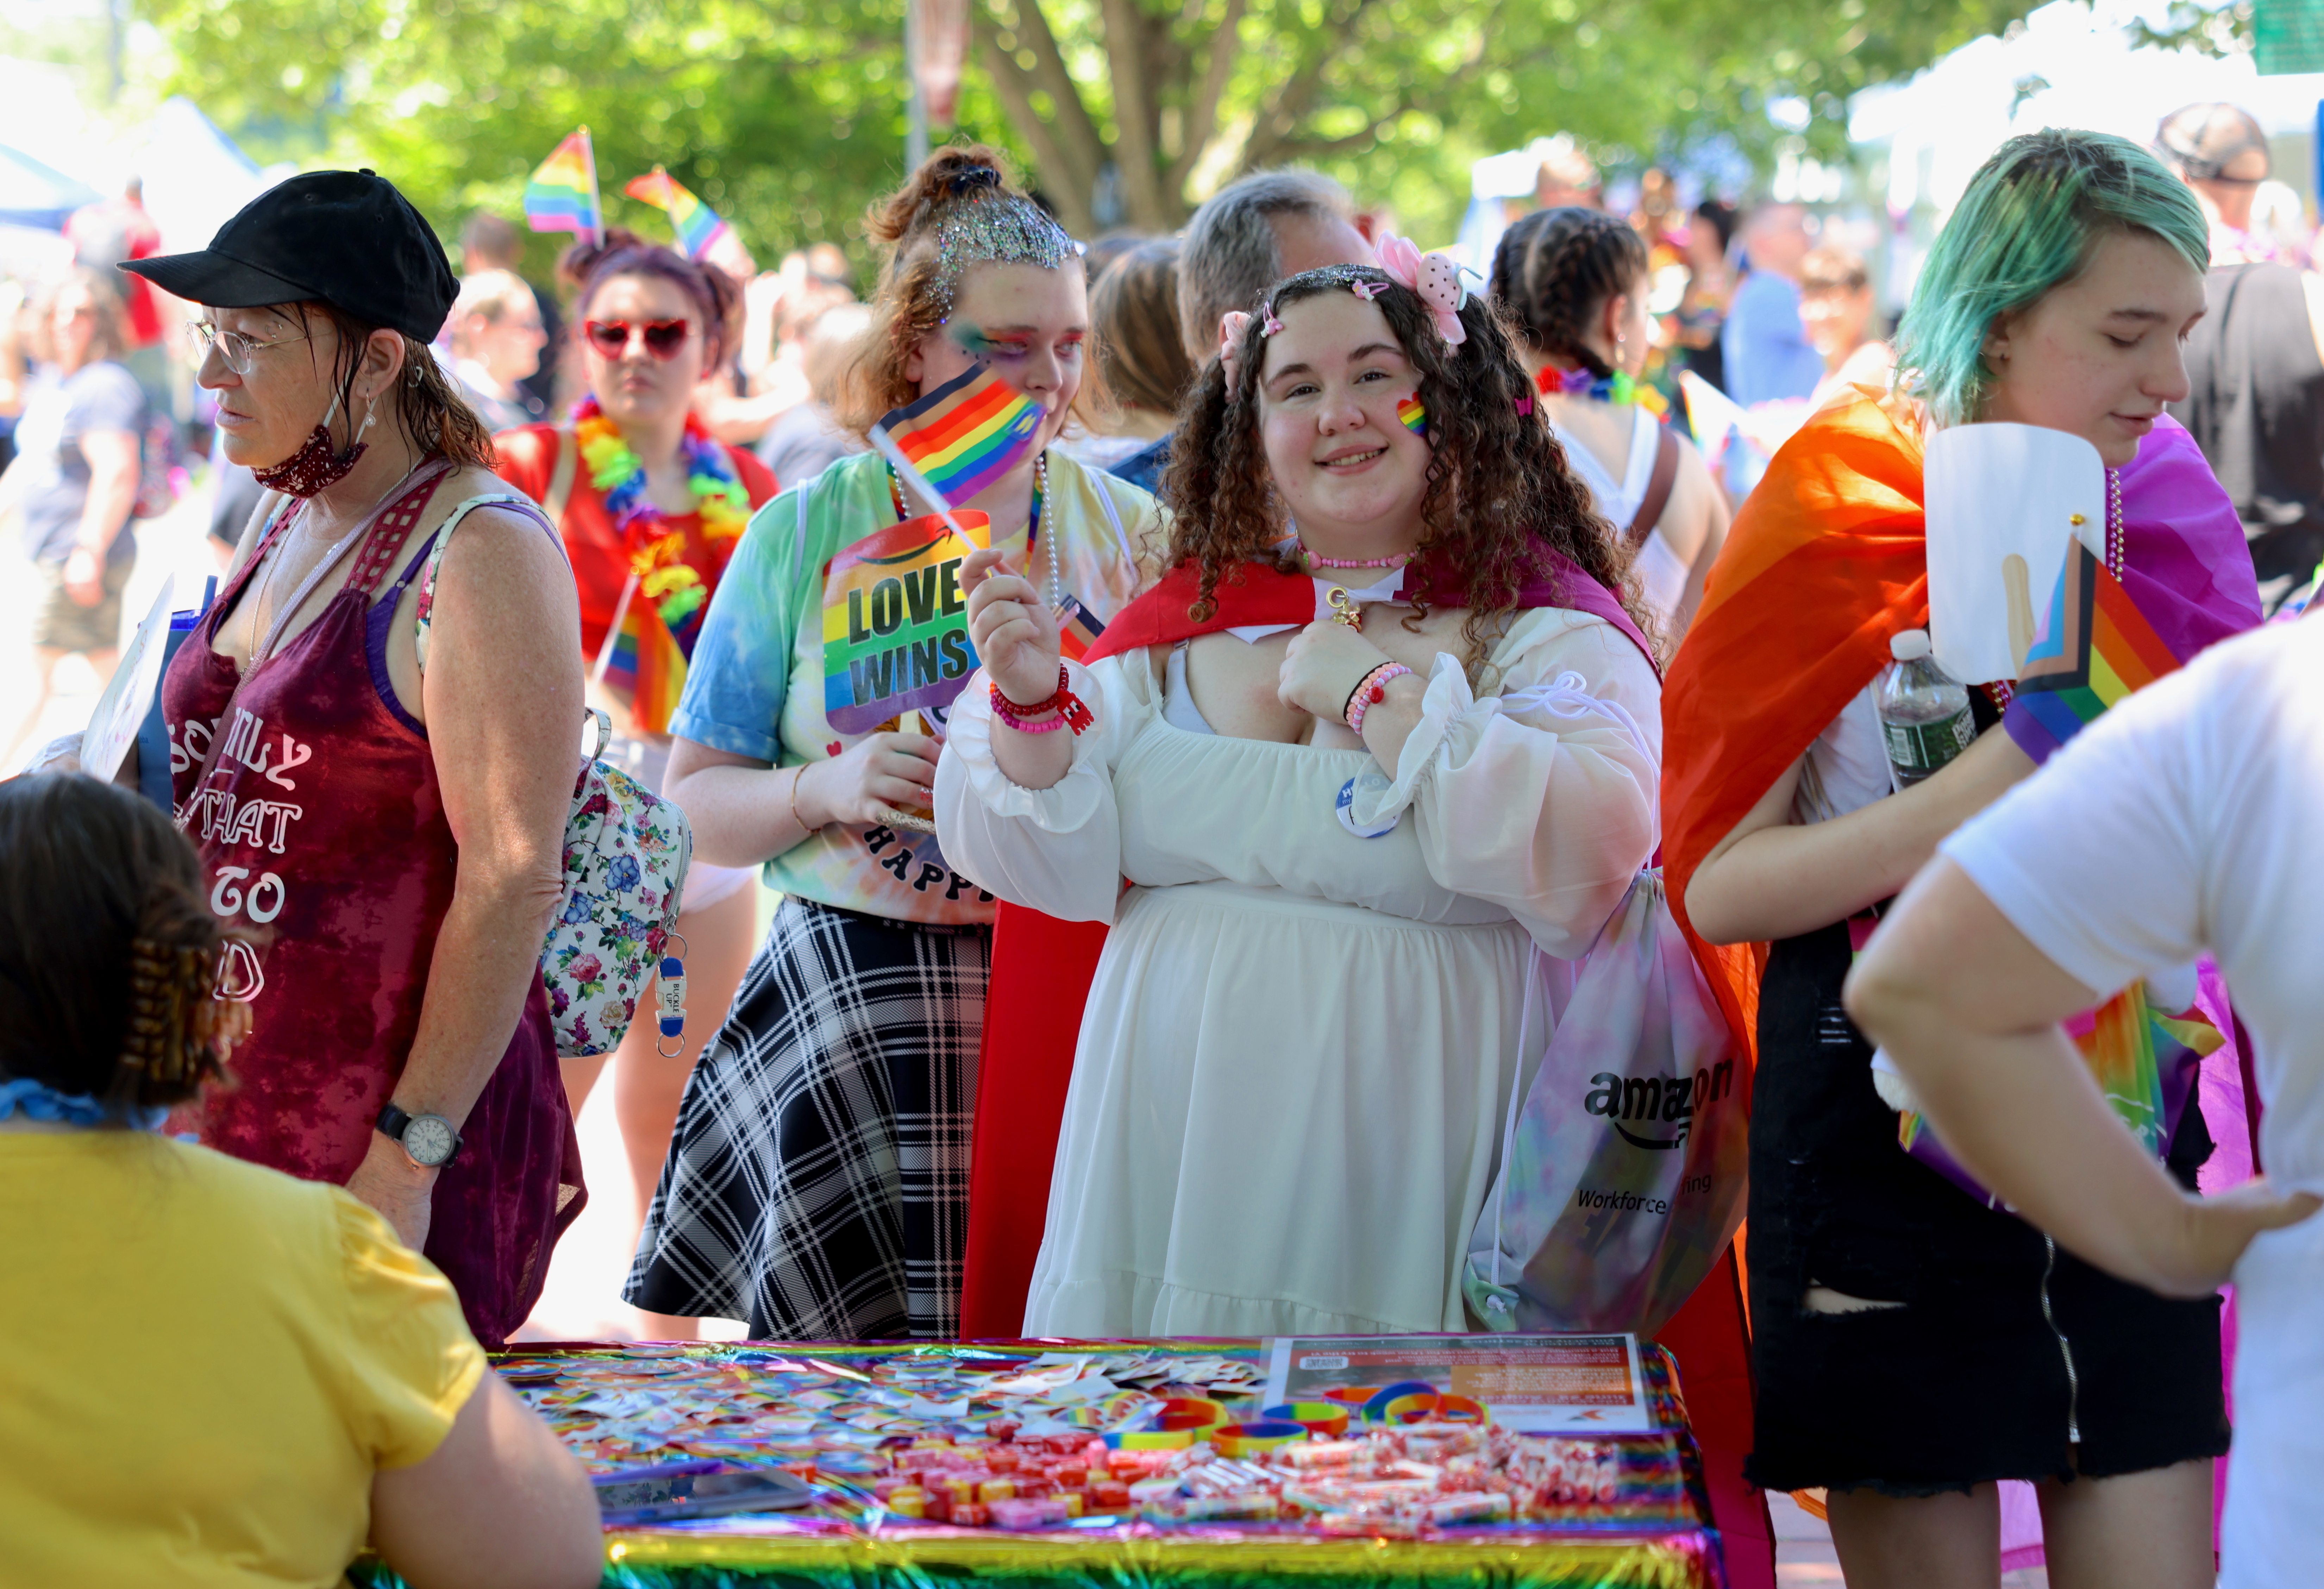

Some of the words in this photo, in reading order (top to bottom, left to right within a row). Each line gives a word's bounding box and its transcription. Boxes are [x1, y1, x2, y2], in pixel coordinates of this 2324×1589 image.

[848, 558, 966, 645] LOVE
[850, 629, 969, 706] WINS
[197, 787, 302, 854] THAT
[1585, 1058, 1734, 1122] amazon
[1578, 1190, 1666, 1214] Workforce
